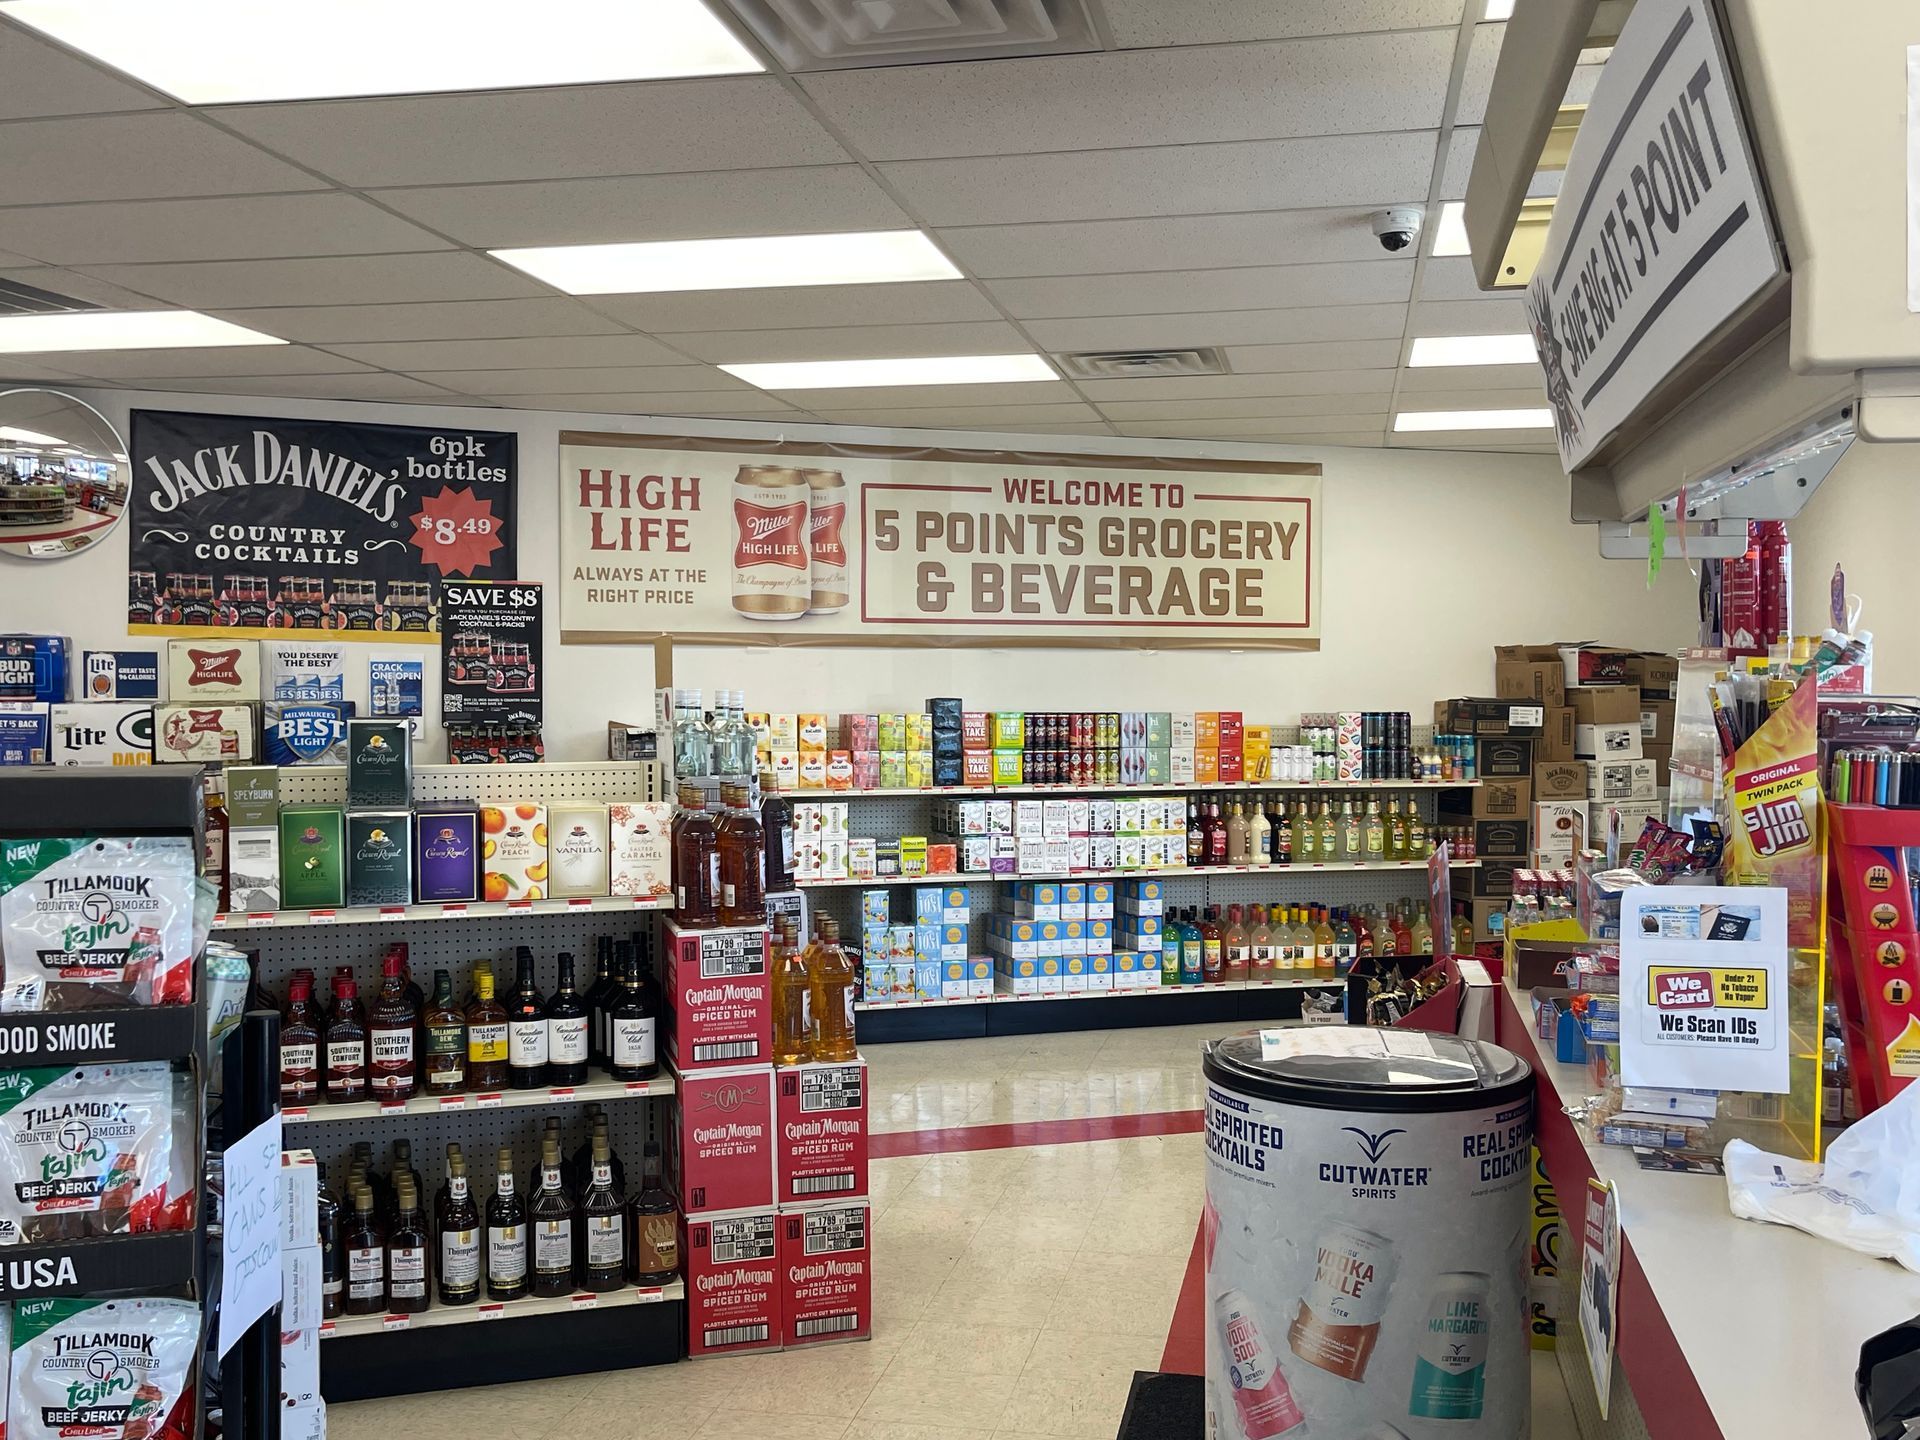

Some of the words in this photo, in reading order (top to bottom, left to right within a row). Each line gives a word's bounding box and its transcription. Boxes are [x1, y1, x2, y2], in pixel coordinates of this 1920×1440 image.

[1630, 58, 1727, 257] POINT
[1616, 188, 1647, 277] 5
[1607, 208, 1633, 311] AT
[1584, 247, 1617, 333] BIG
[1560, 276, 1596, 378] SAVE
[429, 436, 486, 459] 6pk
[144, 444, 250, 513] JACK
[252, 430, 408, 524] DANIEL'S
[408, 457, 508, 483] bottles
[578, 468, 701, 512] HIGH
[1003, 477, 1142, 508] WELCOME
[1150, 483, 1184, 509] TO
[209, 524, 346, 546] COUNTRY
[420, 516, 492, 545] $8.49
[590, 511, 691, 553] LIFE
[746, 514, 794, 540] Miller
[874, 509, 900, 552] 5
[916, 510, 1084, 557] POINTS
[1098, 516, 1300, 561] GROCERY
[195, 544, 360, 565] COCKTAILS
[742, 543, 772, 555] HIGH
[774, 543, 799, 556] LIFE
[816, 542, 839, 554] LIFE
[573, 566, 644, 582] ALWAYS
[648, 568, 671, 582] AT
[674, 569, 707, 583] THE
[587, 588, 639, 604] RIGHT
[645, 589, 694, 605] PRICE
[916, 561, 955, 612] &
[971, 561, 1264, 616] BEVERAGE
[447, 587, 506, 607] SAVE
[509, 586, 538, 608] $8
[459, 620, 495, 628] COCKTAIL
[468, 614, 500, 622] DANIEL'S
[500, 615, 535, 623] COUNTRY
[200, 656, 229, 671] Miller
[277, 652, 297, 660] YOU
[299, 652, 339, 660] DESERVE
[0, 660, 31, 672] BUD
[90, 657, 114, 673] Lite
[372, 663, 403, 672] CRACK
[0, 672, 35, 684] IGHT
[372, 672, 393, 680] ONE
[394, 672, 422, 680] OPEN
[284, 711, 335, 719] MILWAUKEE'S
[18, 720, 38, 728] BACK
[277, 718, 344, 738] BEST
[965, 727, 986, 737] TAKE
[64, 724, 106, 750] Lite
[294, 737, 327, 746] LIGHT
[968, 764, 989, 774] TAKE
[1750, 763, 1801, 784] ORIGINAL
[233, 789, 274, 801] SPEYBURN
[1746, 786, 1774, 802] TWIN
[1776, 778, 1804, 793] PACK
[1743, 799, 1804, 833] slim
[1759, 818, 1810, 856] jim
[6, 842, 41, 863] NEW
[356, 848, 380, 861] Crown
[377, 848, 401, 861] Royal
[620, 851, 662, 859] CARAMEL
[44, 875, 152, 900] TILLAMOOK
[36, 900, 81, 912] COUNTRY
[114, 900, 159, 911] SMOKER
[44, 951, 76, 965] BEEF
[79, 952, 125, 966] JERKY
[1667, 976, 1702, 991] We
[1724, 973, 1745, 983] Under
[1746, 974, 1755, 983] 21
[685, 986, 721, 1006] Captain
[720, 984, 762, 1005] Morgan
[1720, 983, 1730, 991] No
[1731, 984, 1759, 993] Tobacco
[1660, 989, 1710, 1005] Card
[1724, 992, 1734, 1001] No
[1735, 992, 1755, 1003] Vapor
[692, 1010, 731, 1023] SPICED
[733, 1009, 757, 1019] RUM
[706, 1004, 742, 1012] ORIGINAL
[471, 1026, 505, 1034] TULLAMORE
[515, 1027, 544, 1037] Canadian
[1659, 1014, 1684, 1032] We
[1687, 1015, 1726, 1033] Scan
[1731, 1017, 1757, 1035] IDs
[0, 1026, 38, 1055] OOD
[46, 1022, 116, 1053] SMOKE
[373, 1036, 410, 1046] SOUTHERN
[521, 1036, 537, 1045] Club
[1656, 1033, 1666, 1041] ALL
[1666, 1033, 1695, 1042] CUSTOMERS:
[1696, 1034, 1717, 1042] Please
[1717, 1035, 1732, 1043] Have
[1741, 1036, 1760, 1046] Ready
[375, 1045, 409, 1056] COMFORT
[1219, 1095, 1245, 1110] AVAILABLE
[1215, 1108, 1283, 1150] SPIRITED
[1463, 1130, 1506, 1159] REAL
[1233, 1171, 1255, 1183] premium
[1256, 1178, 1276, 1189] mixers.
[1319, 1162, 1428, 1186] CUTWATER
[229, 1164, 254, 1201] ALL
[1352, 1188, 1396, 1199] SPIRITS
[492, 1241, 525, 1251] Thompson
[10, 1256, 78, 1290] USA
[696, 1272, 733, 1293] Captain
[732, 1268, 773, 1287] Morgan
[703, 1297, 741, 1308] SPICED
[744, 1292, 767, 1303] RUM
[717, 1288, 752, 1297] ORIGINAL
[21, 1301, 54, 1317] NEW
[1447, 1301, 1479, 1318] LIME
[703, 1321, 727, 1329] PLASTIC
[738, 1317, 753, 1325] WITH
[1428, 1317, 1488, 1336] MARGARITA
[53, 1332, 154, 1356] TILLAMOOK
[1233, 1340, 1264, 1364] SODA
[42, 1358, 86, 1369] COUNTRY
[120, 1357, 160, 1369] SMOKER
[1441, 1355, 1472, 1364] CUTWATER
[47, 1410, 78, 1424] BEEF
[81, 1408, 126, 1423] JERKY
